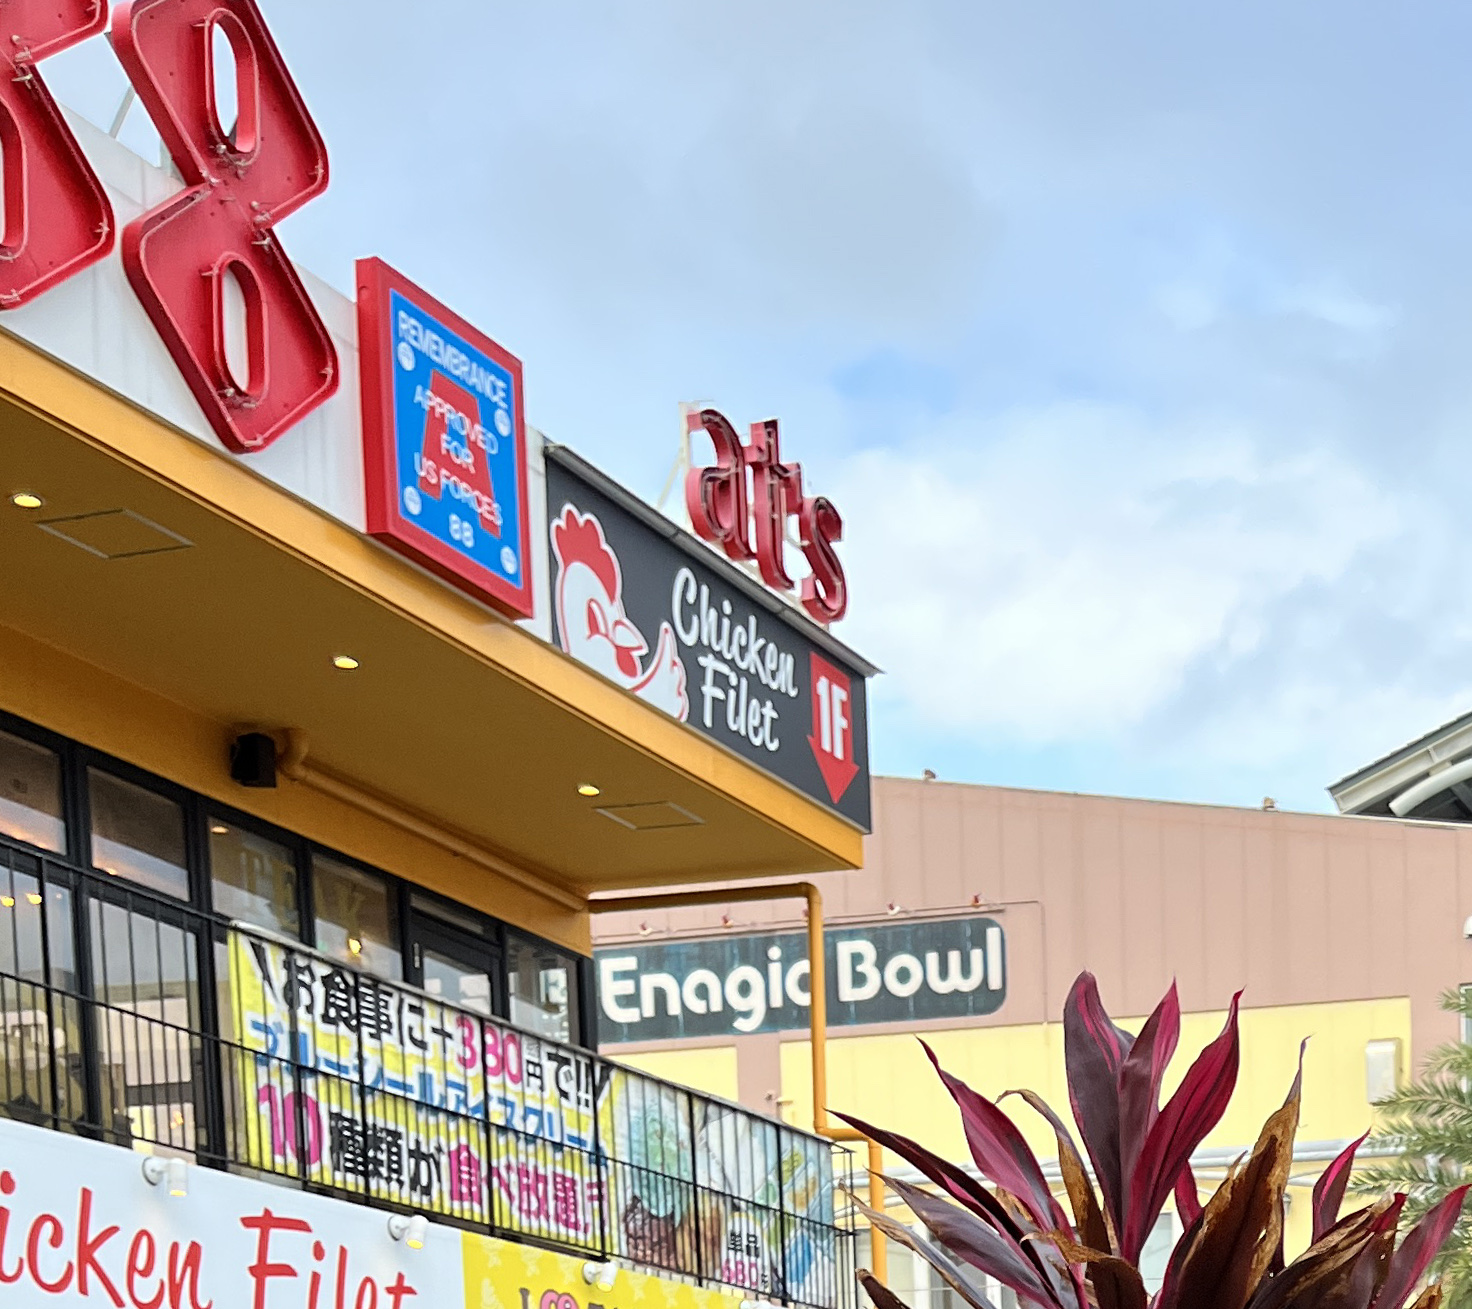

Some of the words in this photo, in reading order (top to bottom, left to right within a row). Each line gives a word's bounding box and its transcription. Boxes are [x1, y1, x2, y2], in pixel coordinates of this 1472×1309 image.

[398, 309, 508, 408] REMEMBRANCE
[414, 385, 499, 455] APPROVED
[440, 432, 476, 475] FOR
[414, 451, 439, 485] US
[440, 466, 504, 527] FORCES
[672, 567, 799, 698] Chicken
[698, 653, 780, 753] Filet
[817, 675, 849, 761] 1F
[600, 945, 811, 1033] Enagic
[836, 927, 1002, 1003] Bowl
